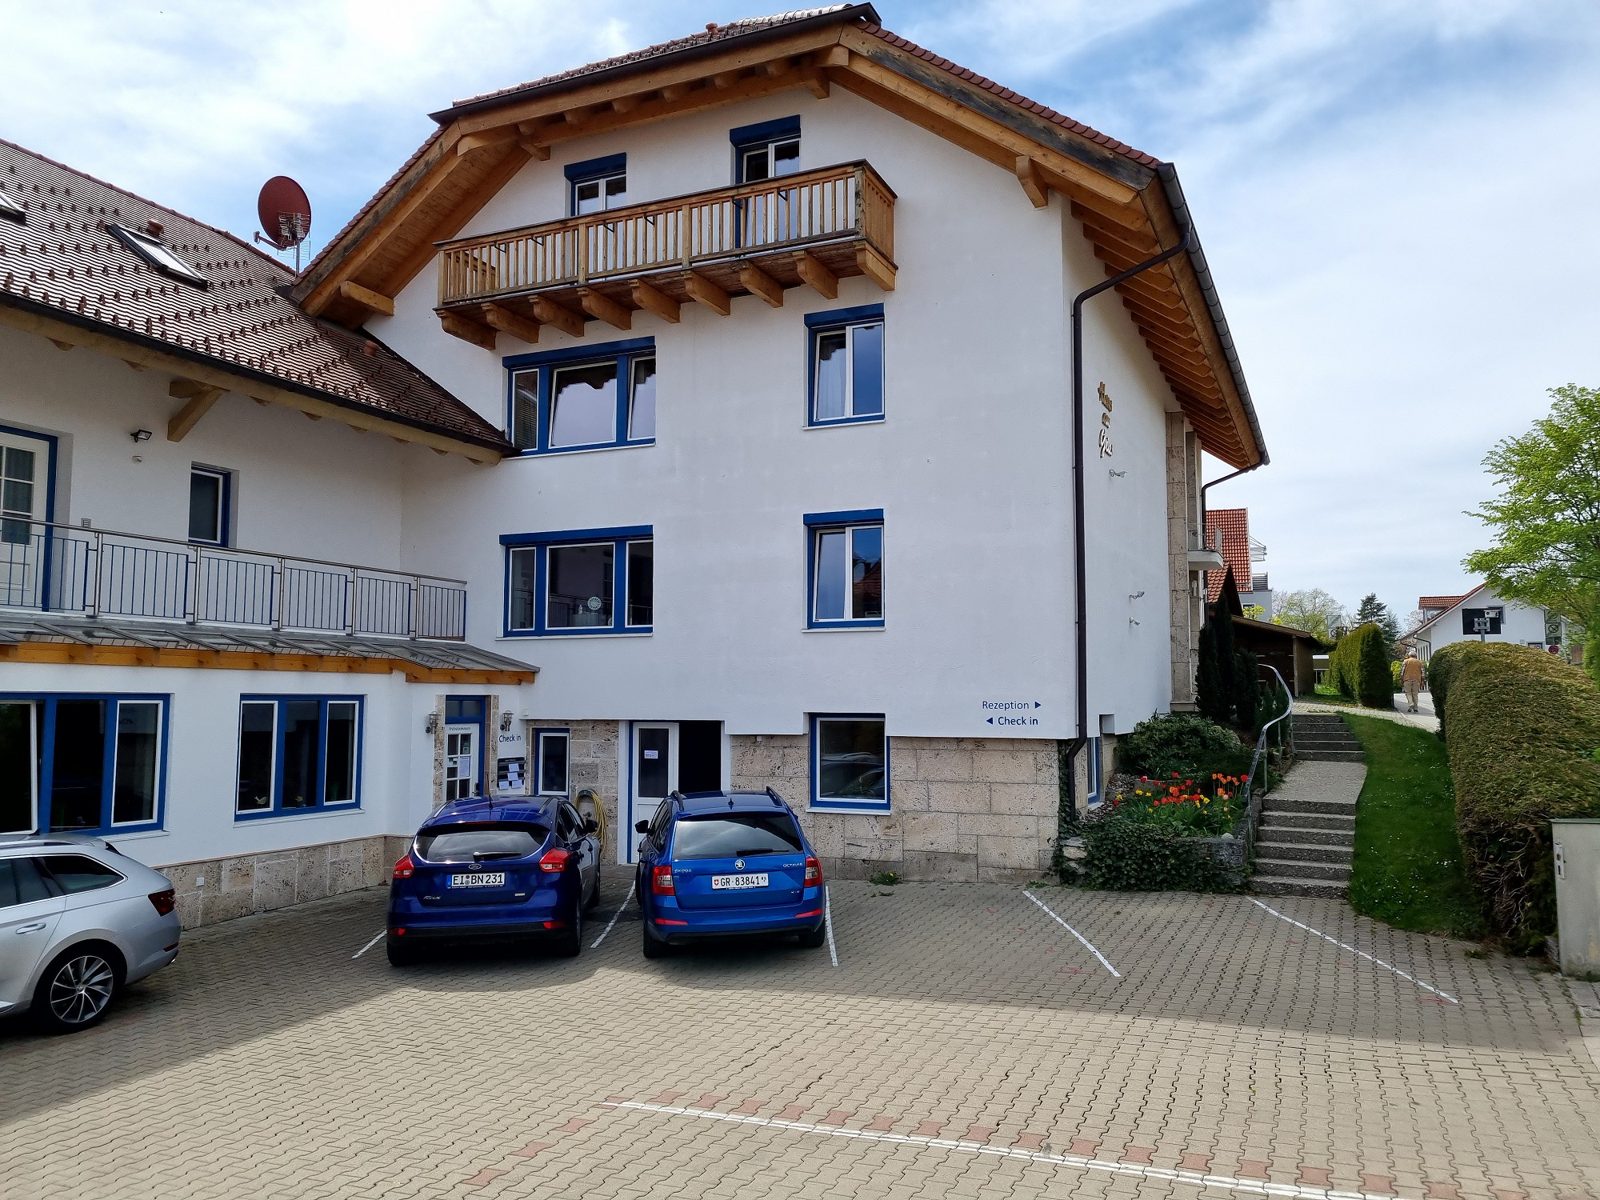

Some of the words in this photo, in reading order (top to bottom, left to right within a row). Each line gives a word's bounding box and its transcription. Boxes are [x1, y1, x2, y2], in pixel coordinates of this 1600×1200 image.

[982, 700, 1030, 711] Rezeption
[997, 716, 1027, 726] Check
[1029, 716, 1039, 726] in
[498, 734, 516, 743] Check
[453, 875, 465, 885] EI
[471, 874, 484, 885] BN
[485, 873, 503, 884] 231
[720, 877, 731, 887] GR
[735, 876, 760, 886] 83841
